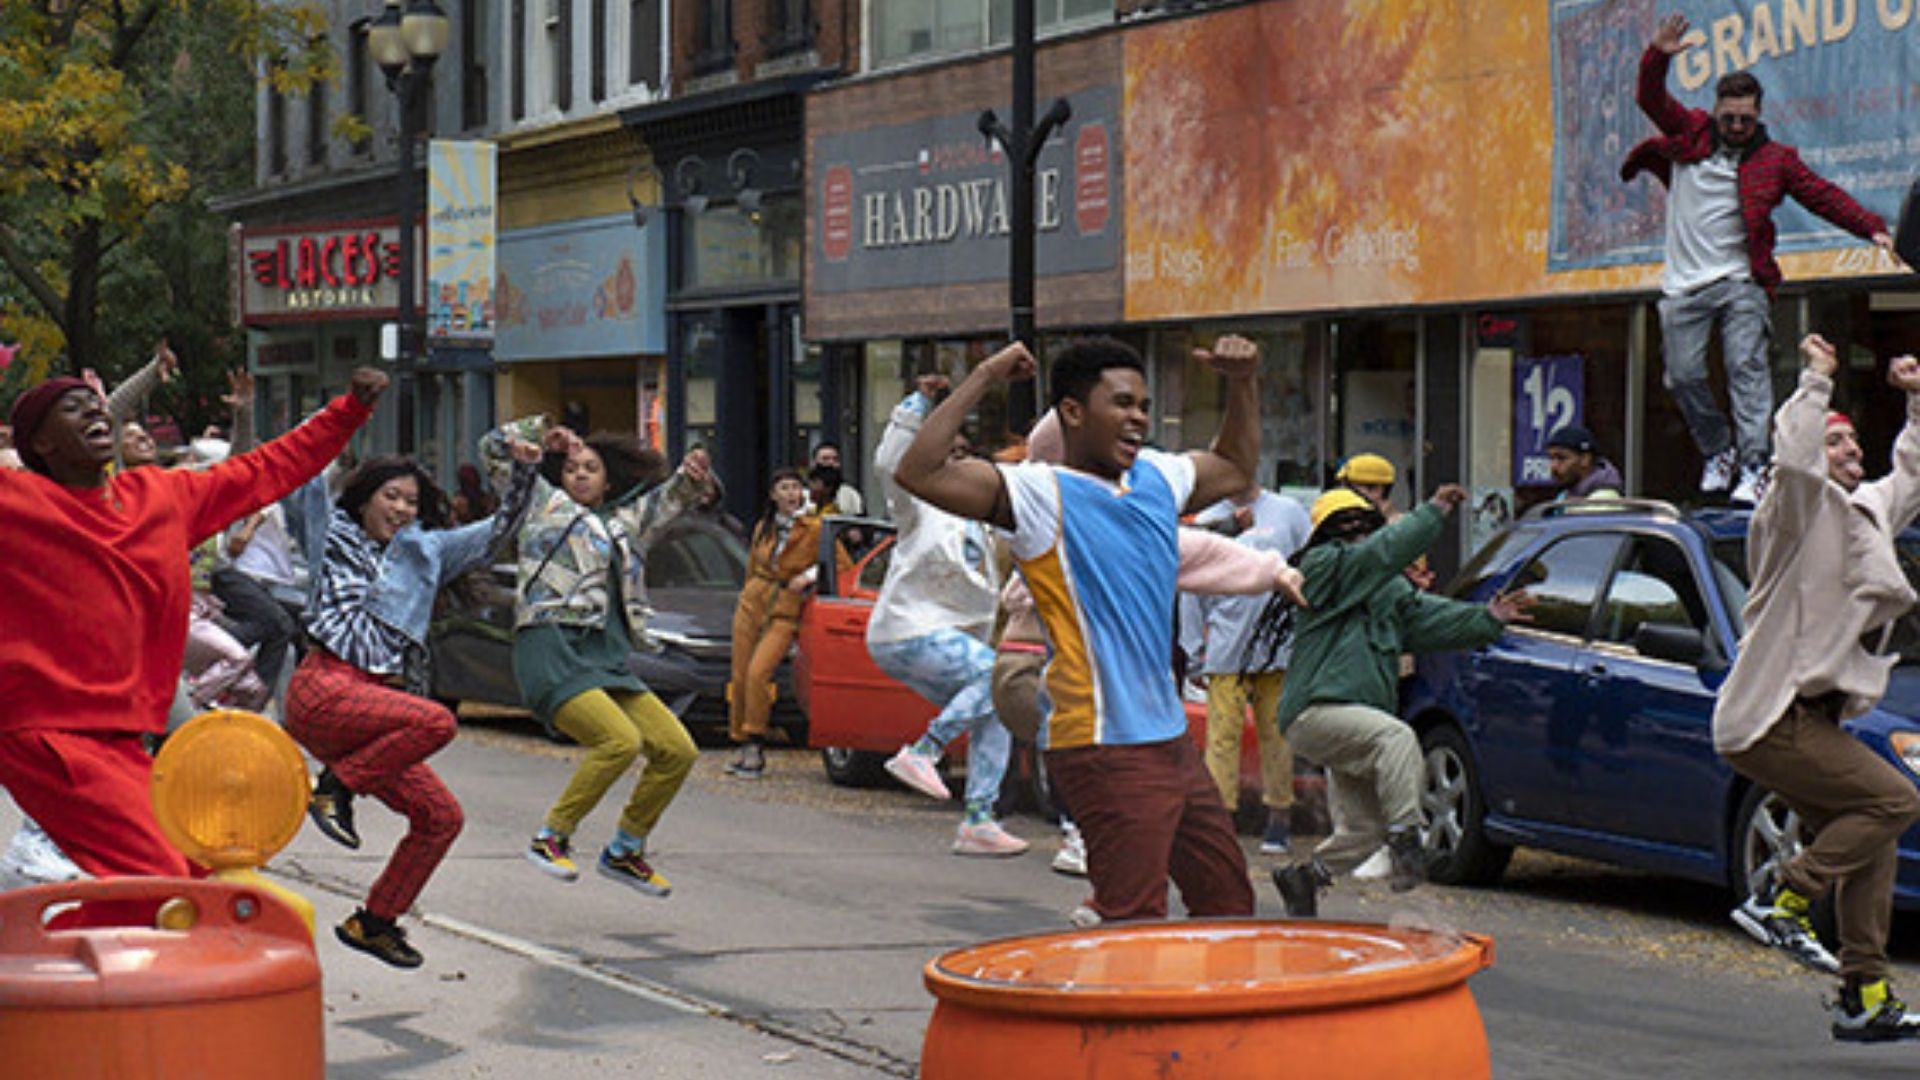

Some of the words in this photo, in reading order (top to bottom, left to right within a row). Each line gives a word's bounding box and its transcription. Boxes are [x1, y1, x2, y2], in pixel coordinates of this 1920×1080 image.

[1675, 0, 1858, 90] GRAND
[862, 168, 1060, 247] HARDWAE
[276, 232, 378, 289] LACES
[287, 288, 373, 307] ASTORIA
